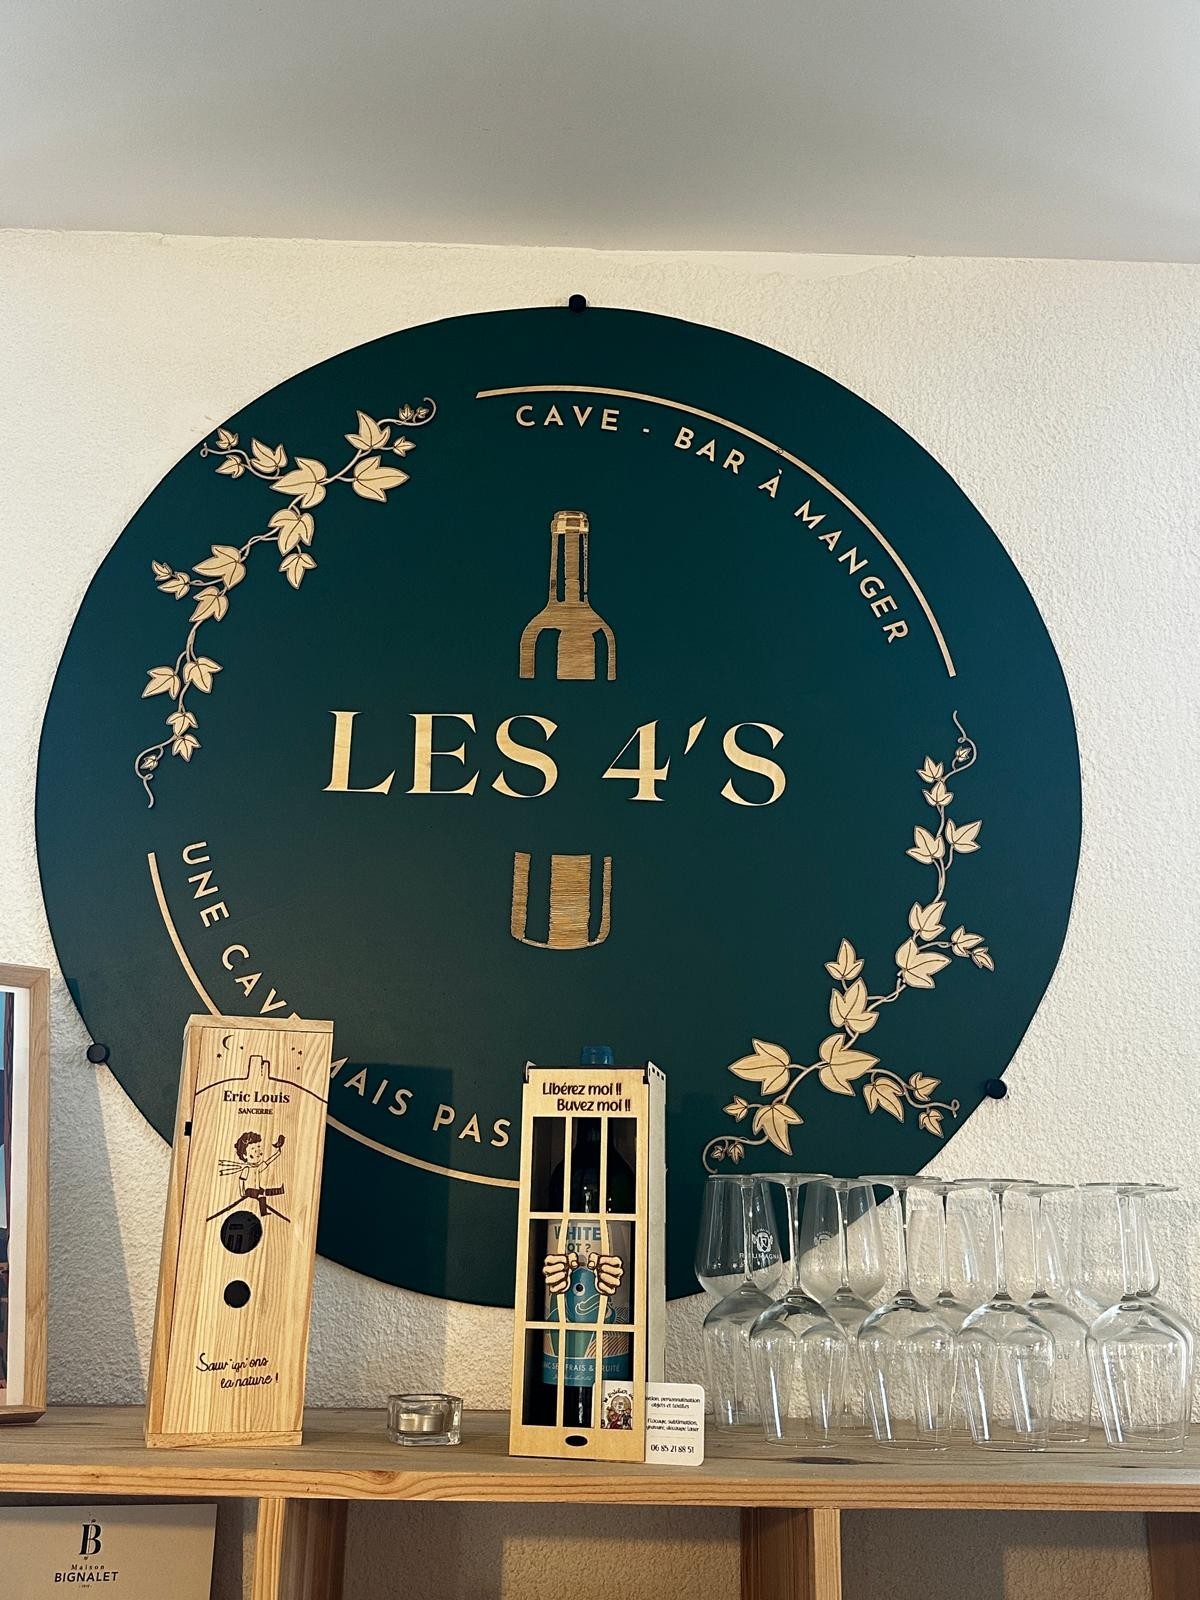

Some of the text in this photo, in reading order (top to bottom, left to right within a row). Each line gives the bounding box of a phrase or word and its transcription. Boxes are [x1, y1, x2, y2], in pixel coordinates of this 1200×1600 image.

[515, 404, 620, 431] CAVE
[674, 426, 745, 474] BAR
[758, 469, 781, 499] À
[793, 499, 909, 644] MANGER
[322, 710, 558, 798] LES
[182, 841, 230, 928] UNE
[221, 943, 300, 1018] CAV
[432, 1103, 511, 1147] PAS
[542, 1082, 586, 1096] Libérez
[588, 1082, 614, 1096] moi
[223, 1090, 290, 1104] Eric Louis
[238, 1107, 273, 1115] SANCERRE
[557, 1098, 595, 1112] Buvez
[597, 1098, 622, 1112] moi
[234, 1374, 273, 1388] nature
[54, 1571, 119, 1583] BIGNALET
